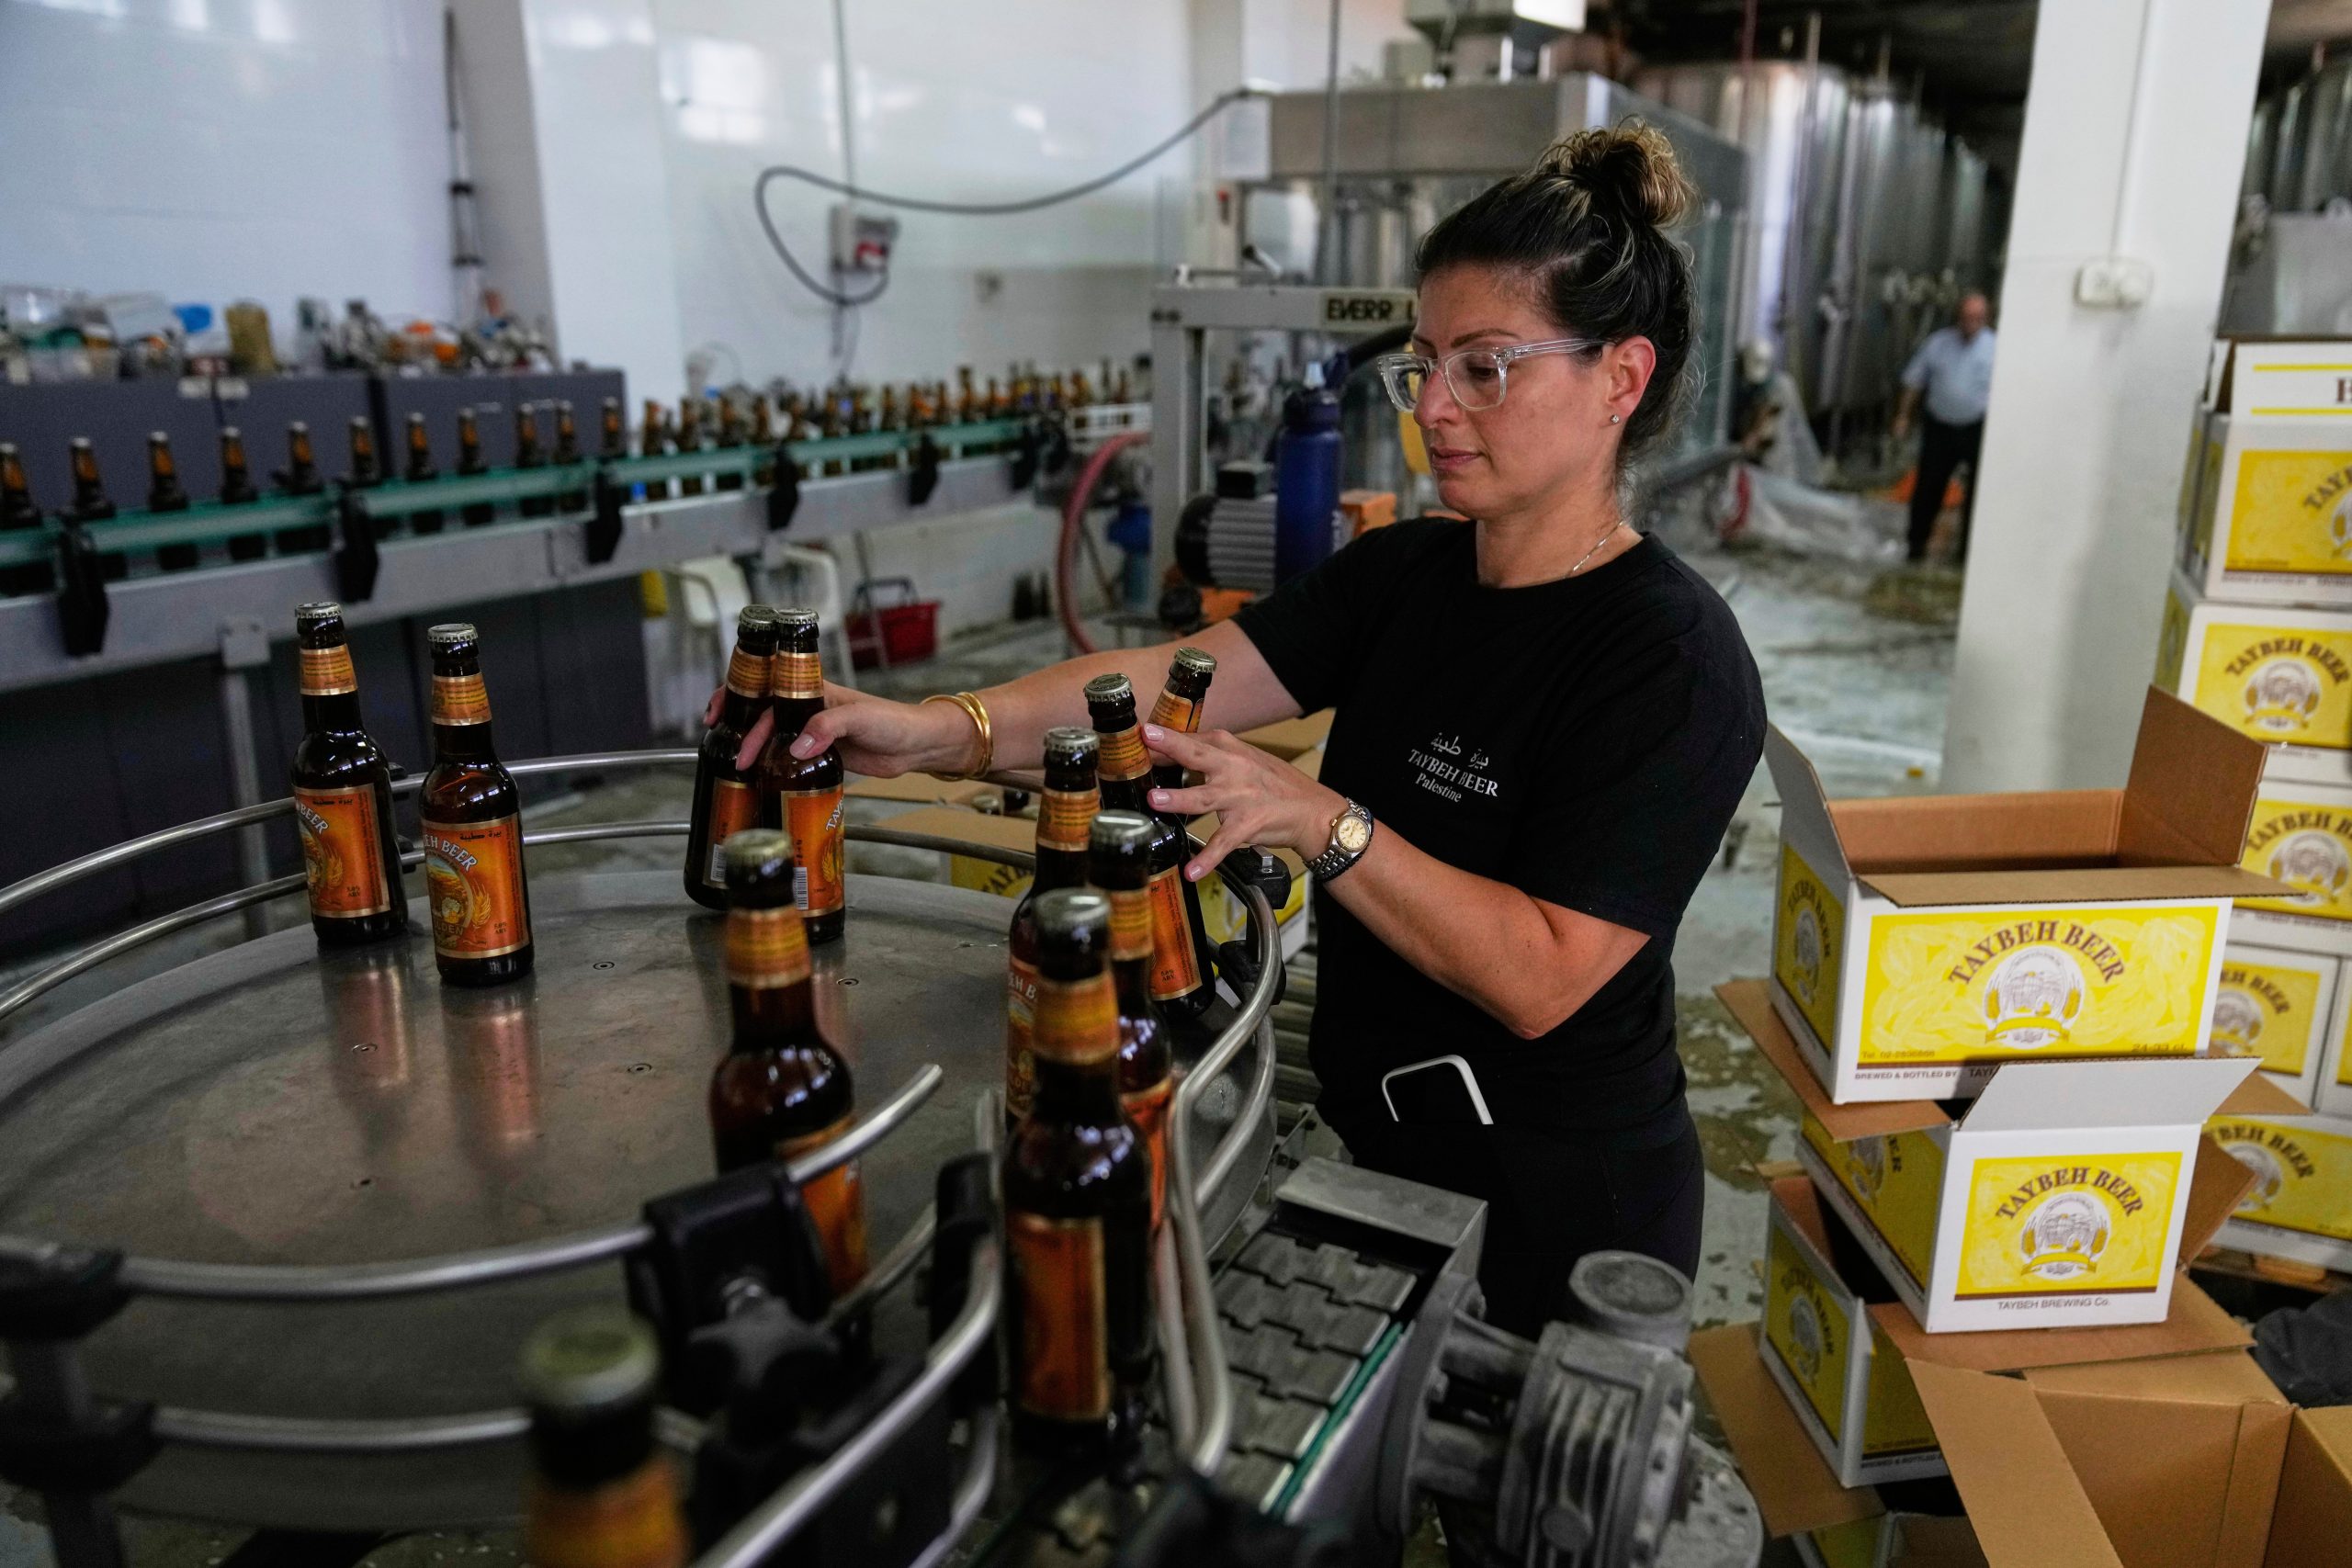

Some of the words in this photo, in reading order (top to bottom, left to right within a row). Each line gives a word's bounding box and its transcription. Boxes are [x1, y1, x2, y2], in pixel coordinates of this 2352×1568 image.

[2306, 642, 2350, 683] BEER
[1408, 749, 1460, 782] TAYBEH
[1458, 772, 1498, 796] BEER
[1415, 773, 1462, 803] Palestine
[300, 803, 329, 834] BEER
[441, 840, 478, 872] BEER
[1948, 920, 2060, 985] TAYBEH
[2061, 923, 2124, 984] BEER
[1855, 1071, 1893, 1080] BREWED
[1903, 1071, 1943, 1079] BOTTLED
[1945, 1070, 1958, 1078] BY
[2268, 1134, 2315, 1179] BEER
[1996, 1167, 2091, 1220] TAYBEH
[2092, 1168, 2143, 1218] BEER
[1998, 1301, 2039, 1310] TAYBEH
[2041, 1298, 2091, 1309] BREWING
